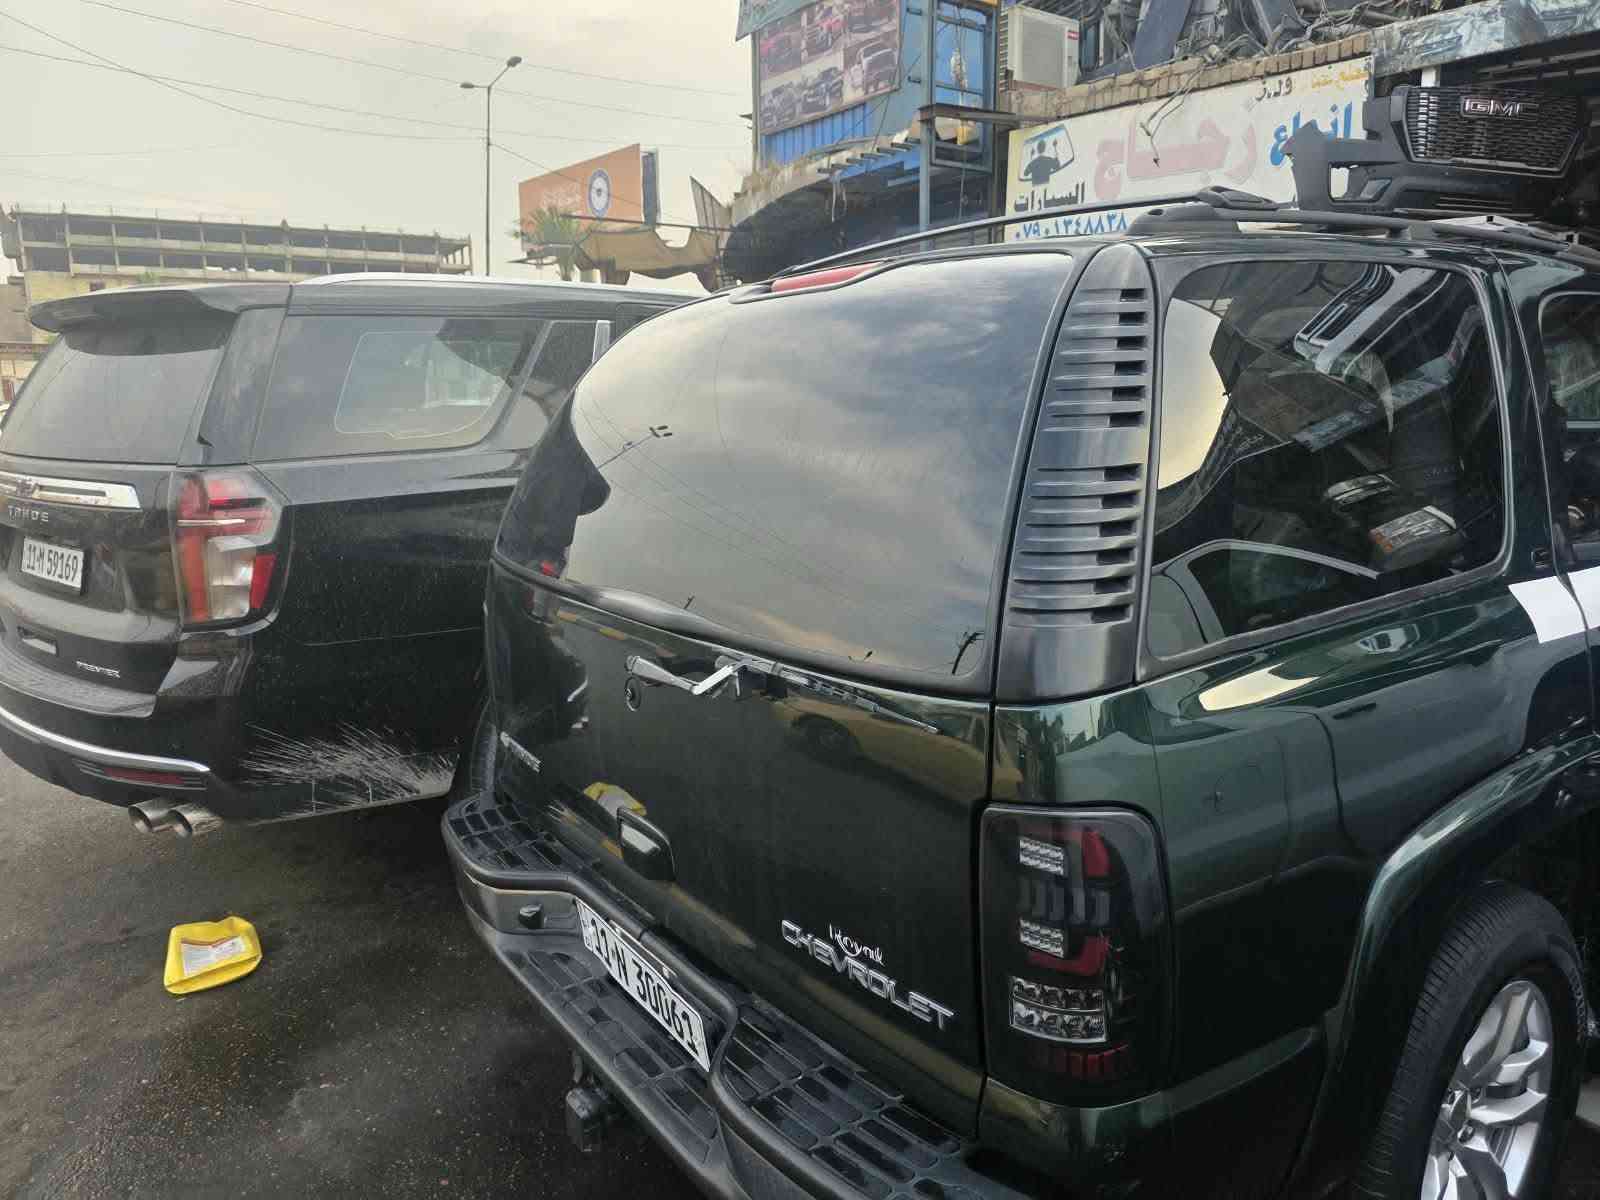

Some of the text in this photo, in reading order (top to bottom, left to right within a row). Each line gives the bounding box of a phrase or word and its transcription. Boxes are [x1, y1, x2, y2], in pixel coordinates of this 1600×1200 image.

[1464, 98, 1540, 117] GMC
[46, 549, 79, 582] 59169
[632, 957, 700, 1056] 30061
[781, 919, 955, 1031] CHEVROLET
